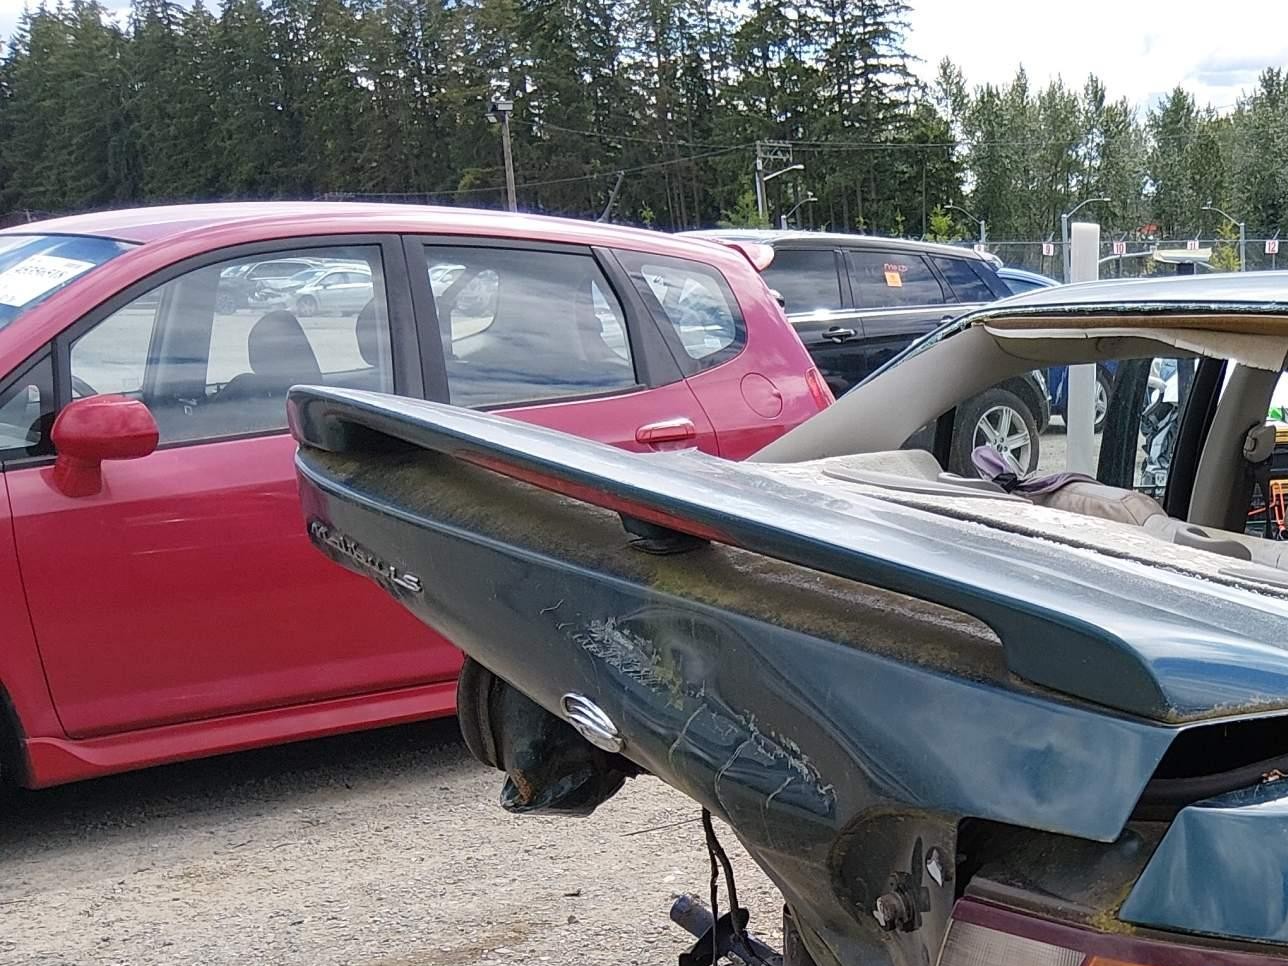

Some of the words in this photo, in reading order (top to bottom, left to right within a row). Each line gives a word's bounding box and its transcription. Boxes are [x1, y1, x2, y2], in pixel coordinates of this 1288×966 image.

[1045, 244, 1051, 255] 9
[1116, 243, 1124, 254] 10
[1268, 241, 1276, 253] 12
[389, 566, 421, 592] LS
